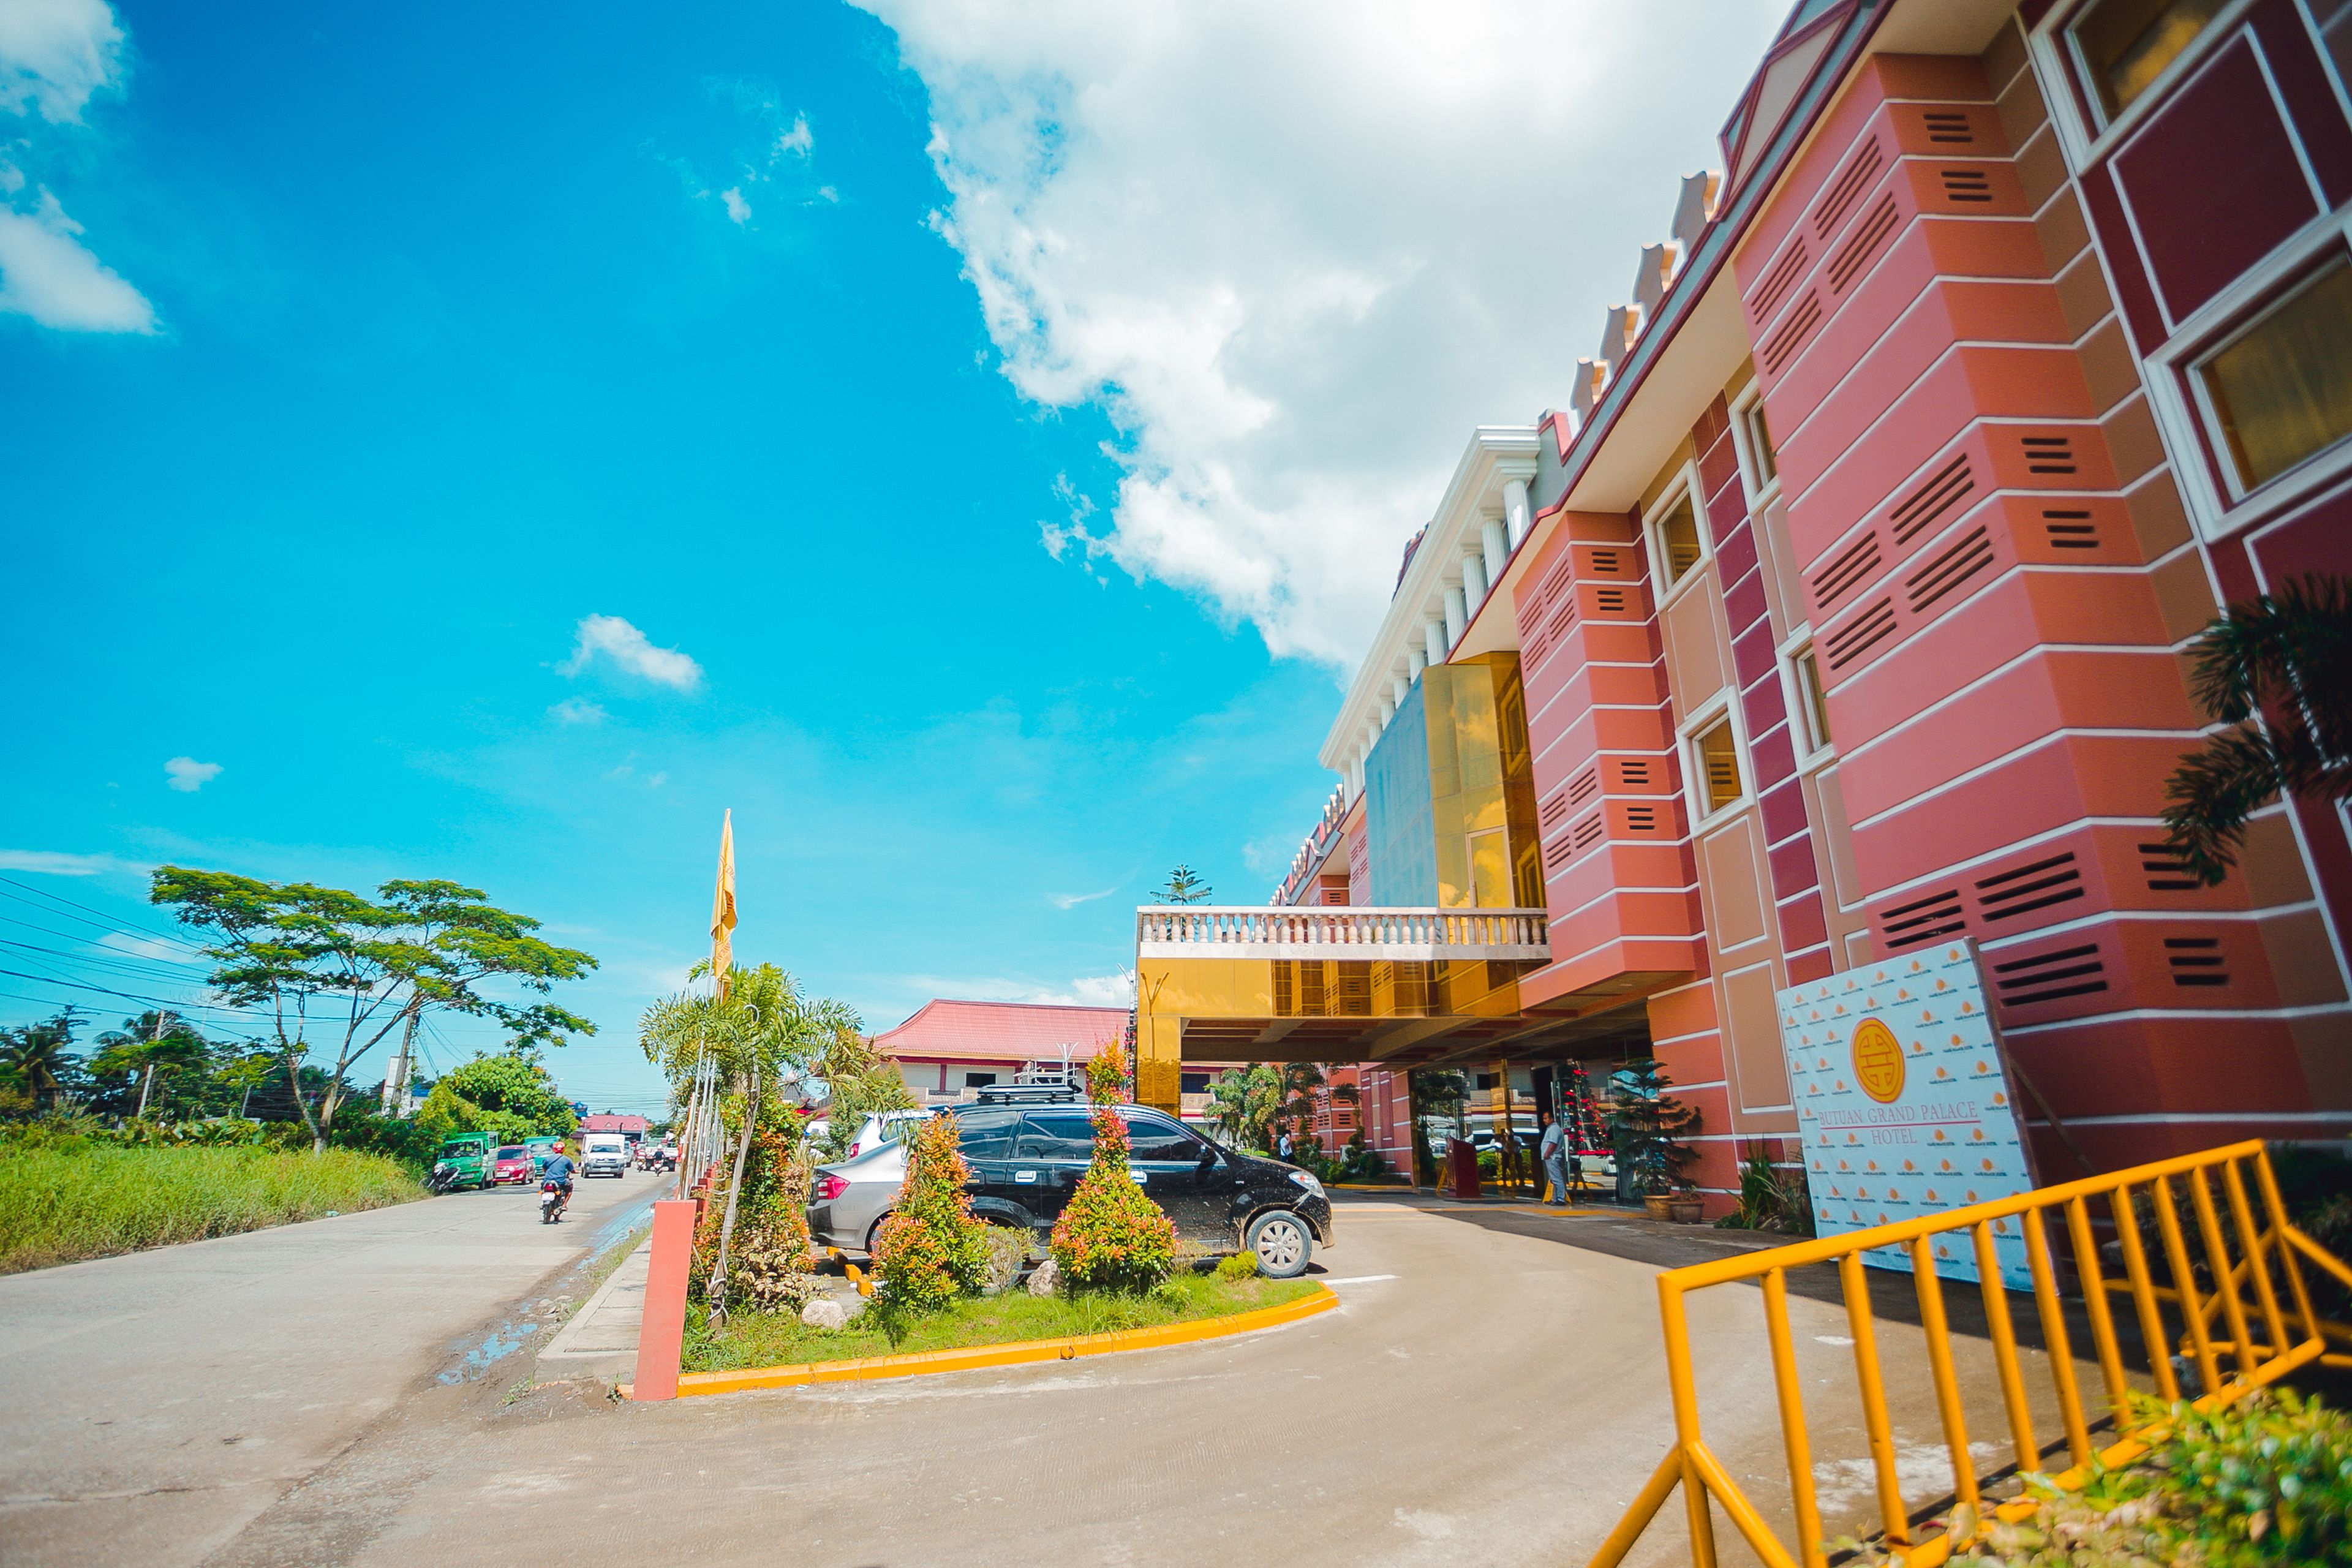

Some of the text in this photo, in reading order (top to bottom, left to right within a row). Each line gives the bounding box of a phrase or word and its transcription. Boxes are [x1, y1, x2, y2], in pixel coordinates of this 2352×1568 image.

[1818, 1101, 1978, 1125] BUTUAN GRAND PALACE
[1871, 1128, 1917, 1145] HOTEL
